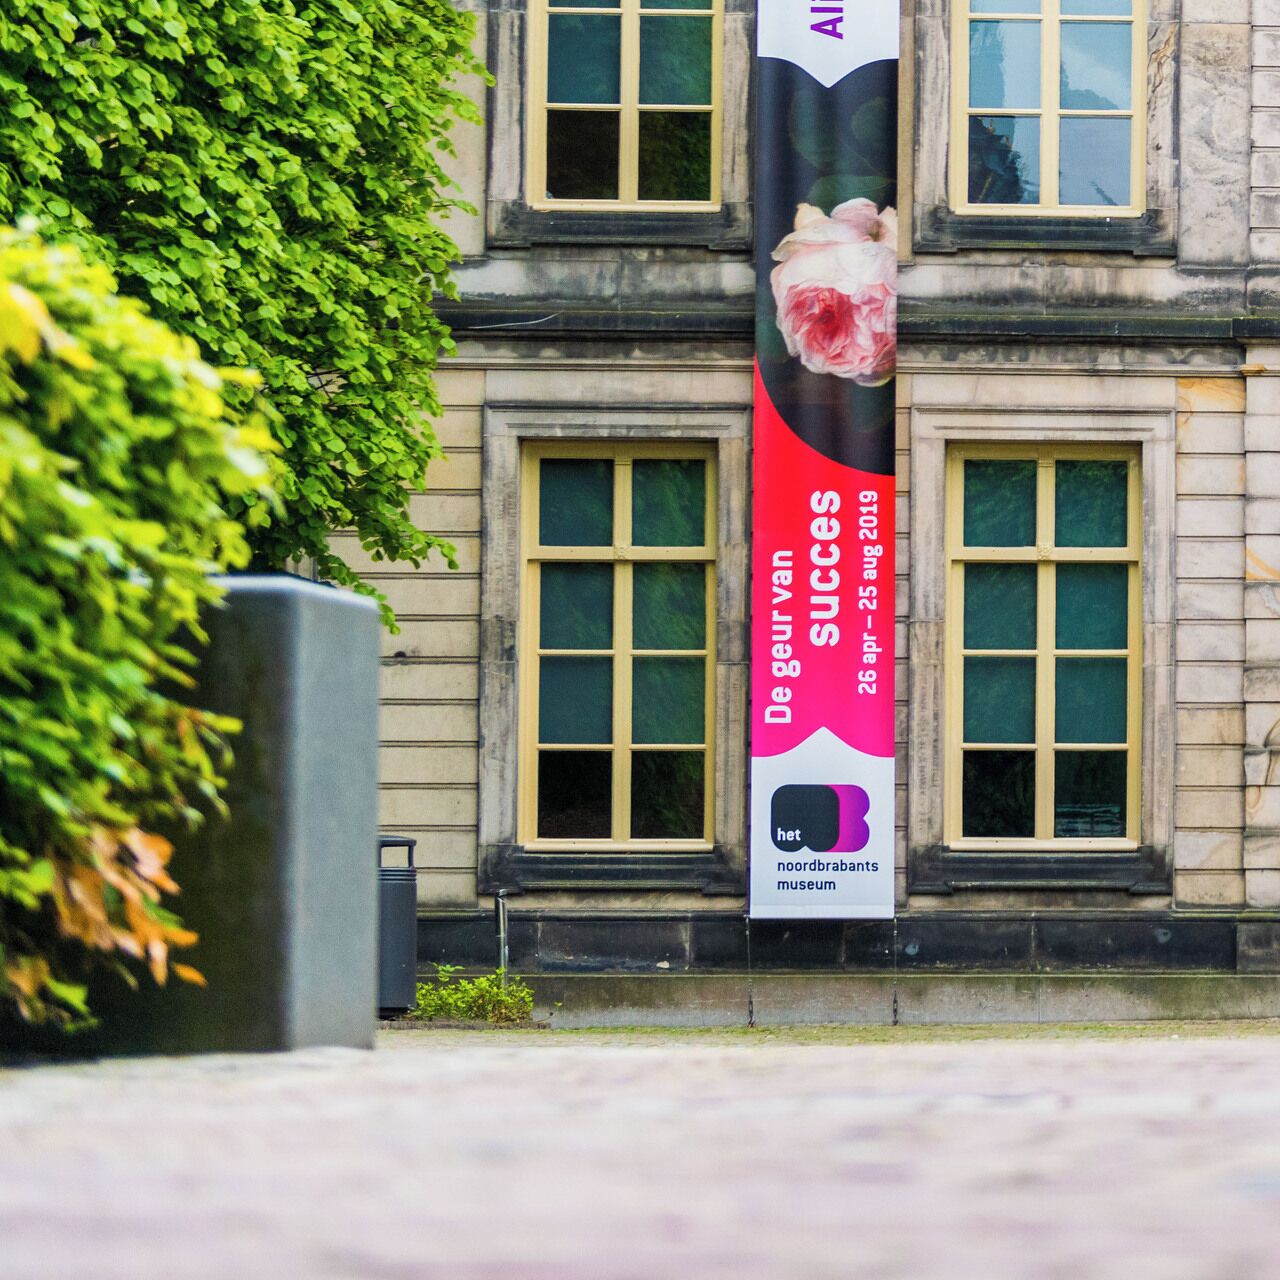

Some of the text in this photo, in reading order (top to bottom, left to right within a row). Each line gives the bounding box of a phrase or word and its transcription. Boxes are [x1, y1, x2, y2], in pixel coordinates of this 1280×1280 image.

[858, 490, 879, 540] 2019
[809, 490, 841, 647] succes
[863, 544, 884, 581] aug
[858, 585, 878, 611] 25
[764, 550, 801, 724] De geur van
[862, 632, 883, 665] apr
[858, 669, 877, 695] 26
[776, 827, 802, 841] het
[776, 859, 879, 872] noordbrabants
[776, 879, 837, 891] museum
